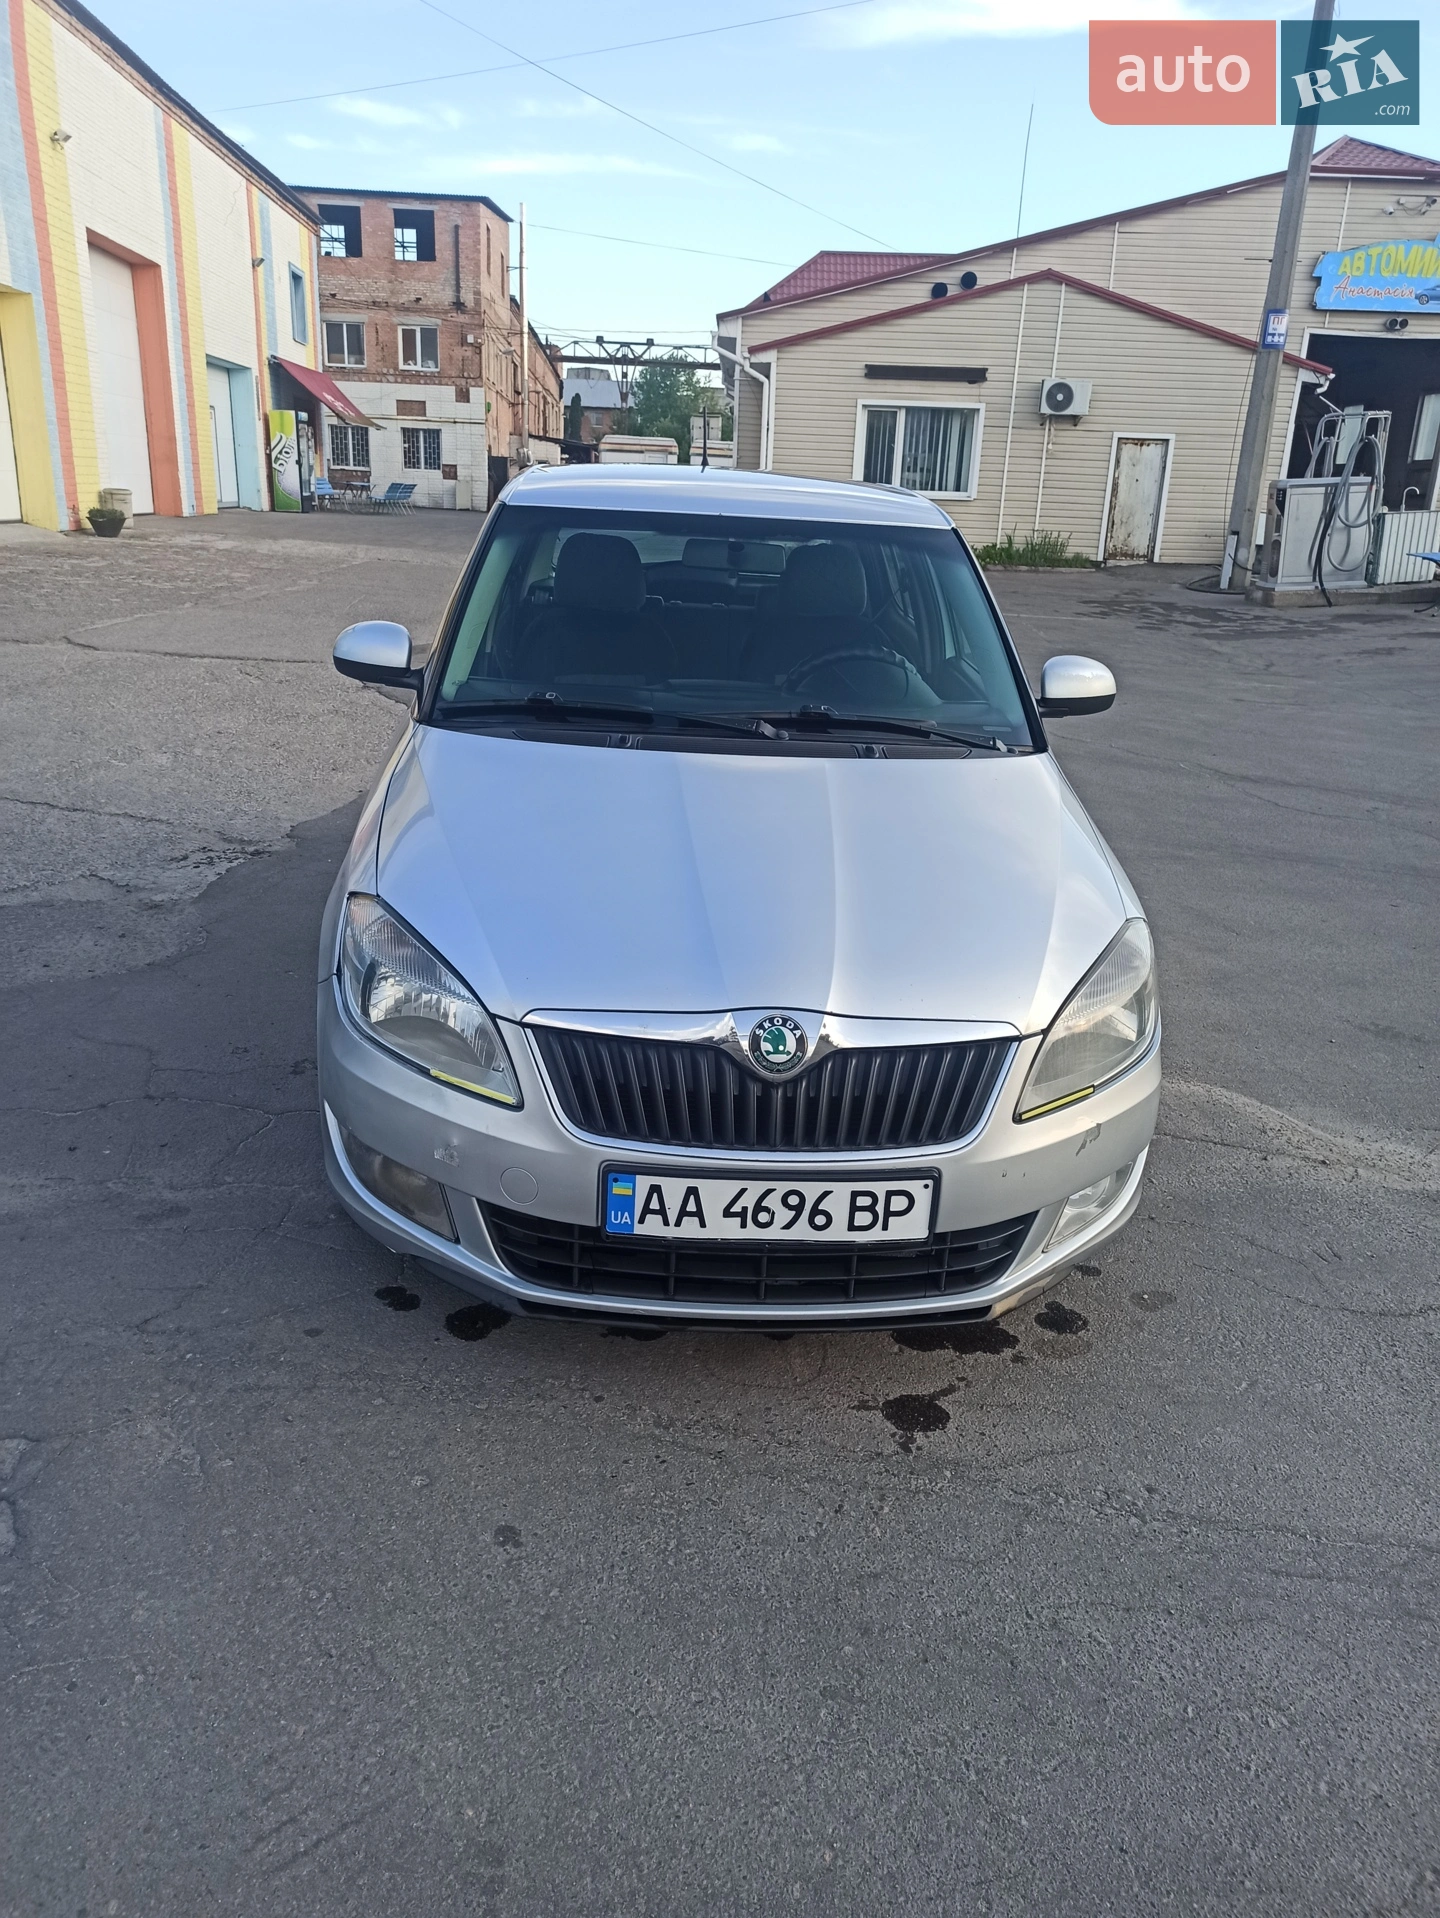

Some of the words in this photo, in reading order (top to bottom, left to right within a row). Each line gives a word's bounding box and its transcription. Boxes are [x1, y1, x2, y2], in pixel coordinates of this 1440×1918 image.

[1329, 274, 1416, 303] Анастасія
[611, 1211, 632, 1225] UA
[722, 1187, 834, 1232] 4696
